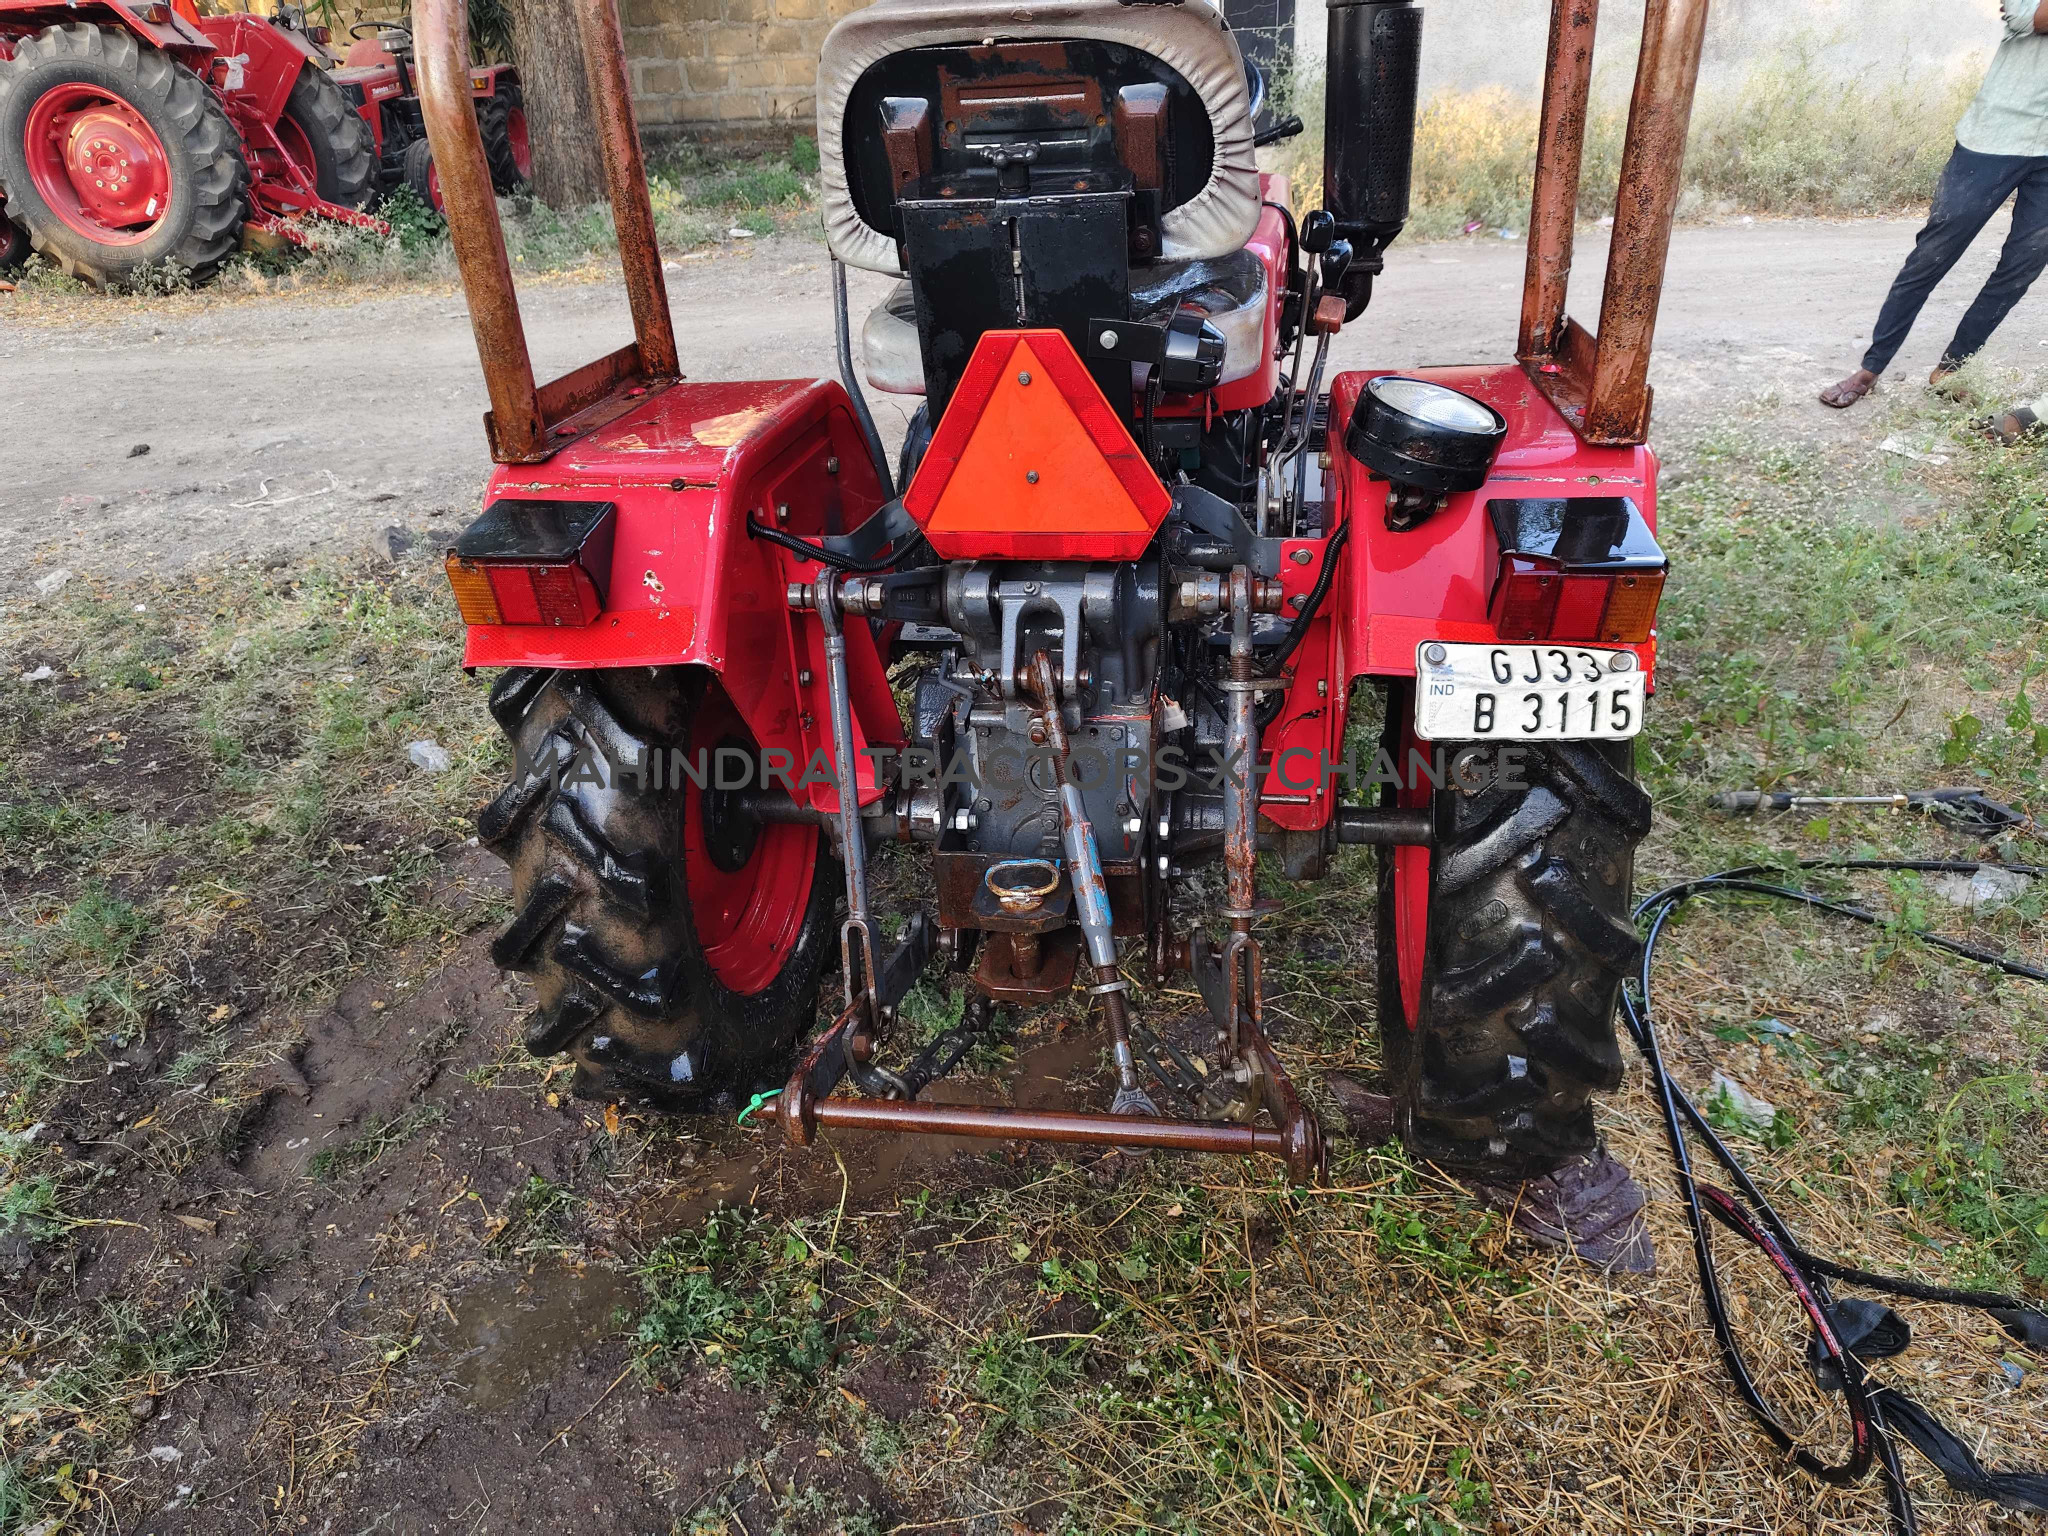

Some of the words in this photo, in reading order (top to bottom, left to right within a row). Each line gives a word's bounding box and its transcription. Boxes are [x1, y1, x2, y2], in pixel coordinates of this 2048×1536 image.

[1490, 649, 1602, 684] GJ33
[1429, 684, 1455, 696] IND
[1473, 693, 1496, 733] B
[1521, 689, 1631, 733] 3115
